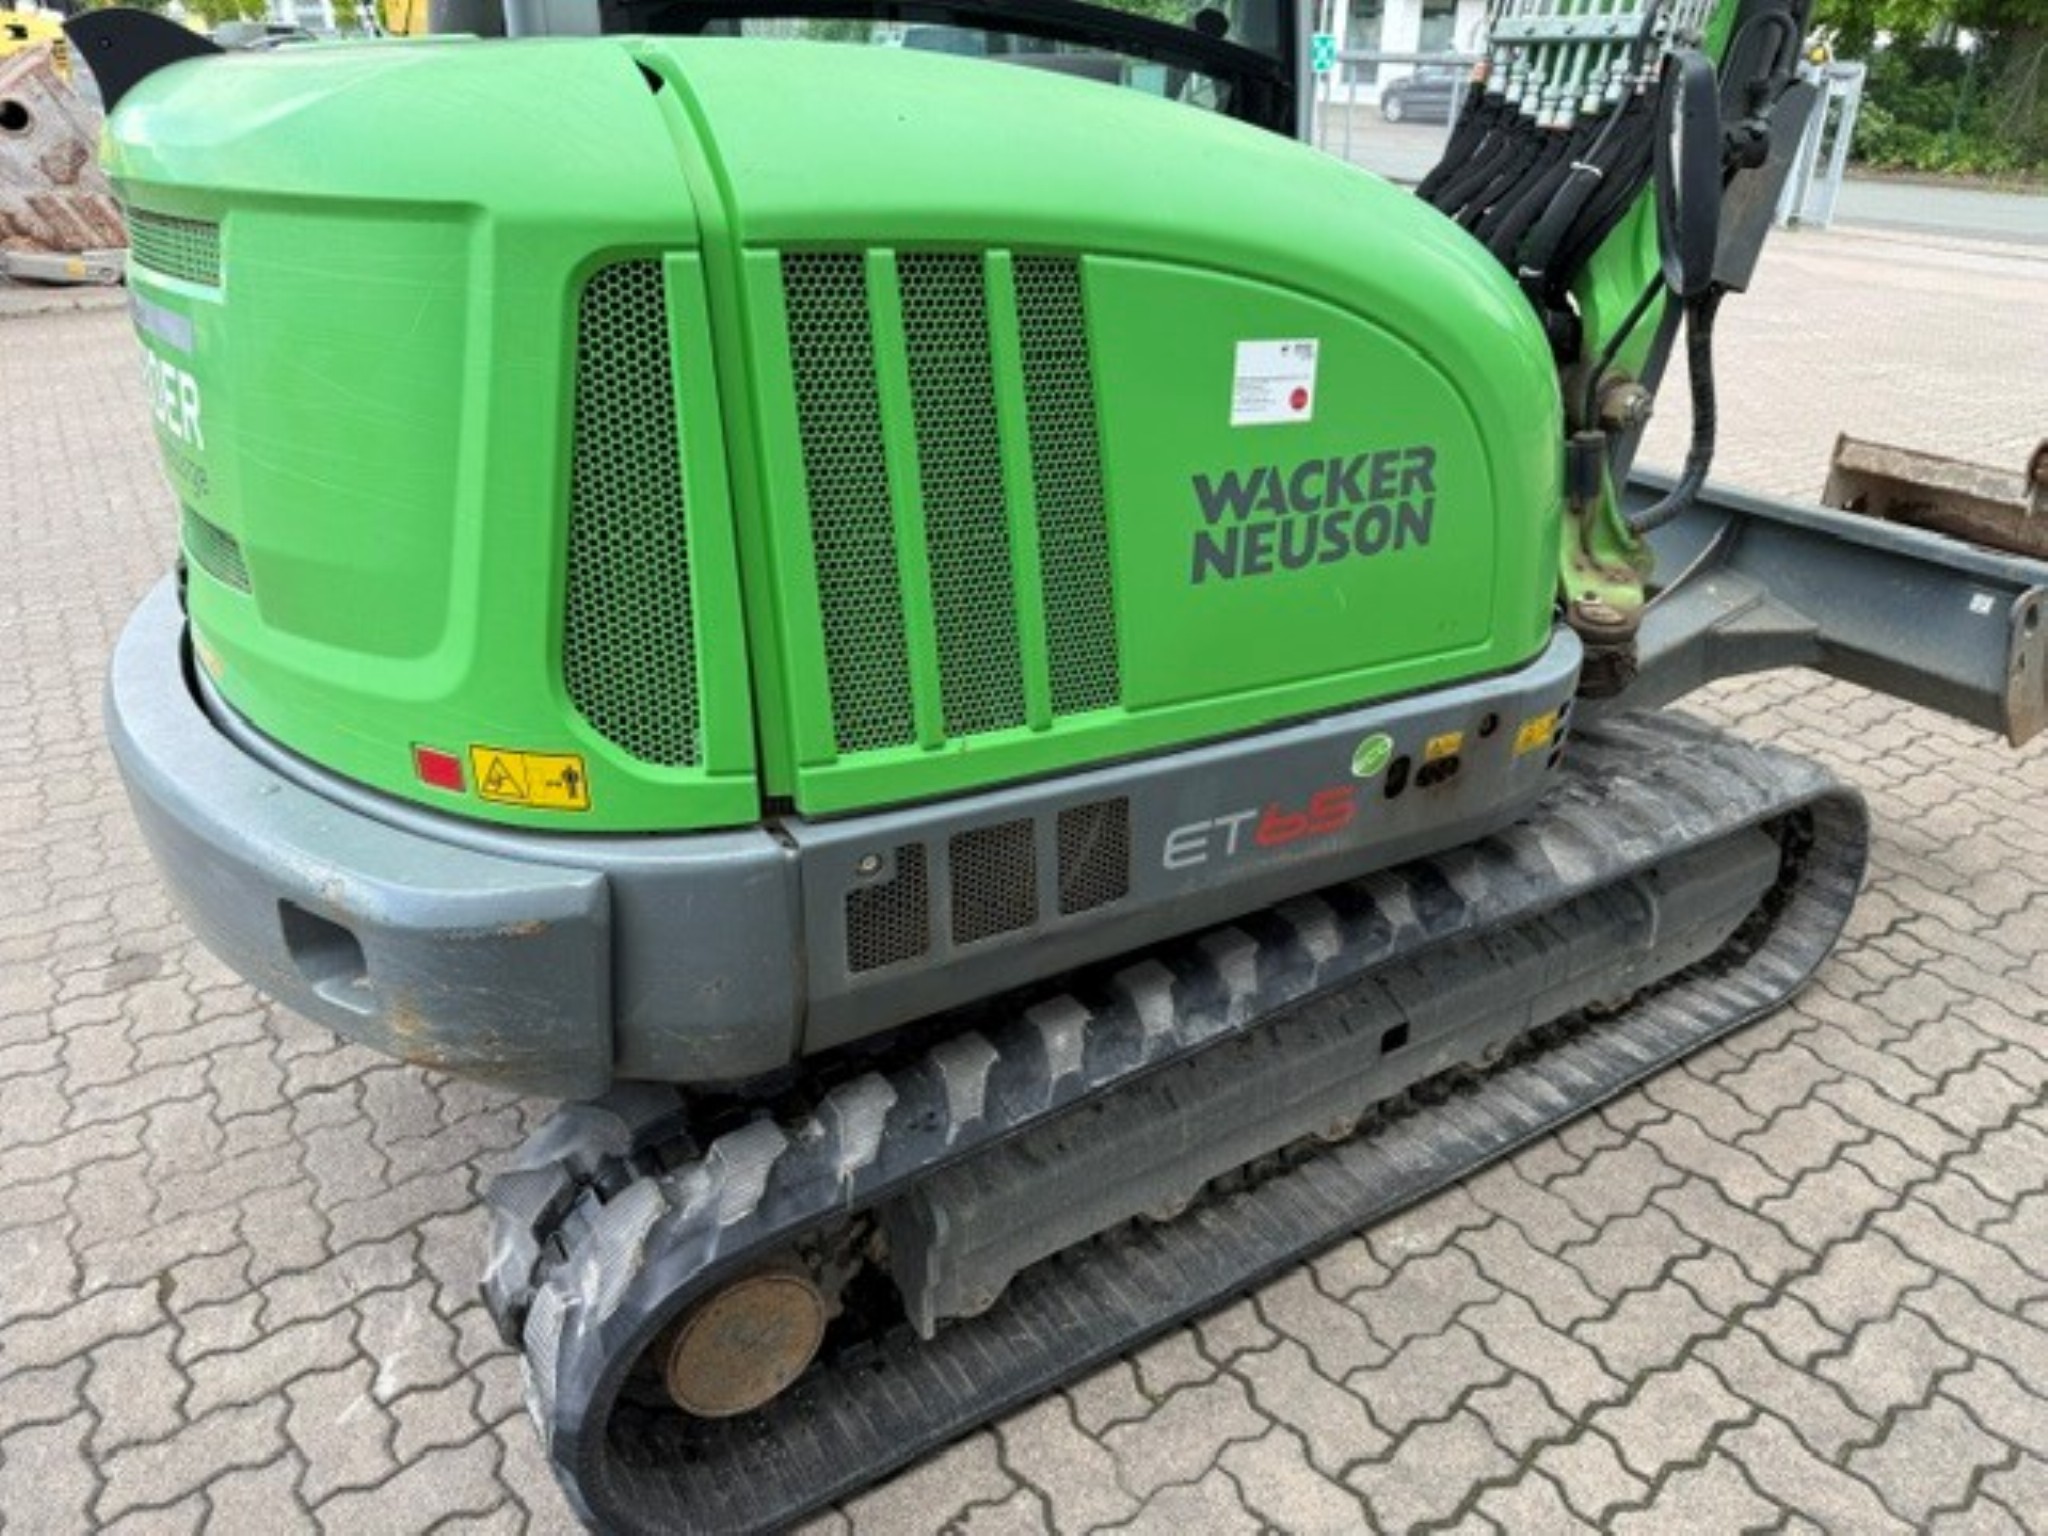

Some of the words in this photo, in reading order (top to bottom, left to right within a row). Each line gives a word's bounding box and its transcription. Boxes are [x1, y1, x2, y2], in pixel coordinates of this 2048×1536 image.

[1191, 446, 1437, 525] WACKER
[1190, 497, 1435, 584] NEUSON
[1163, 785, 1360, 870] ET65
